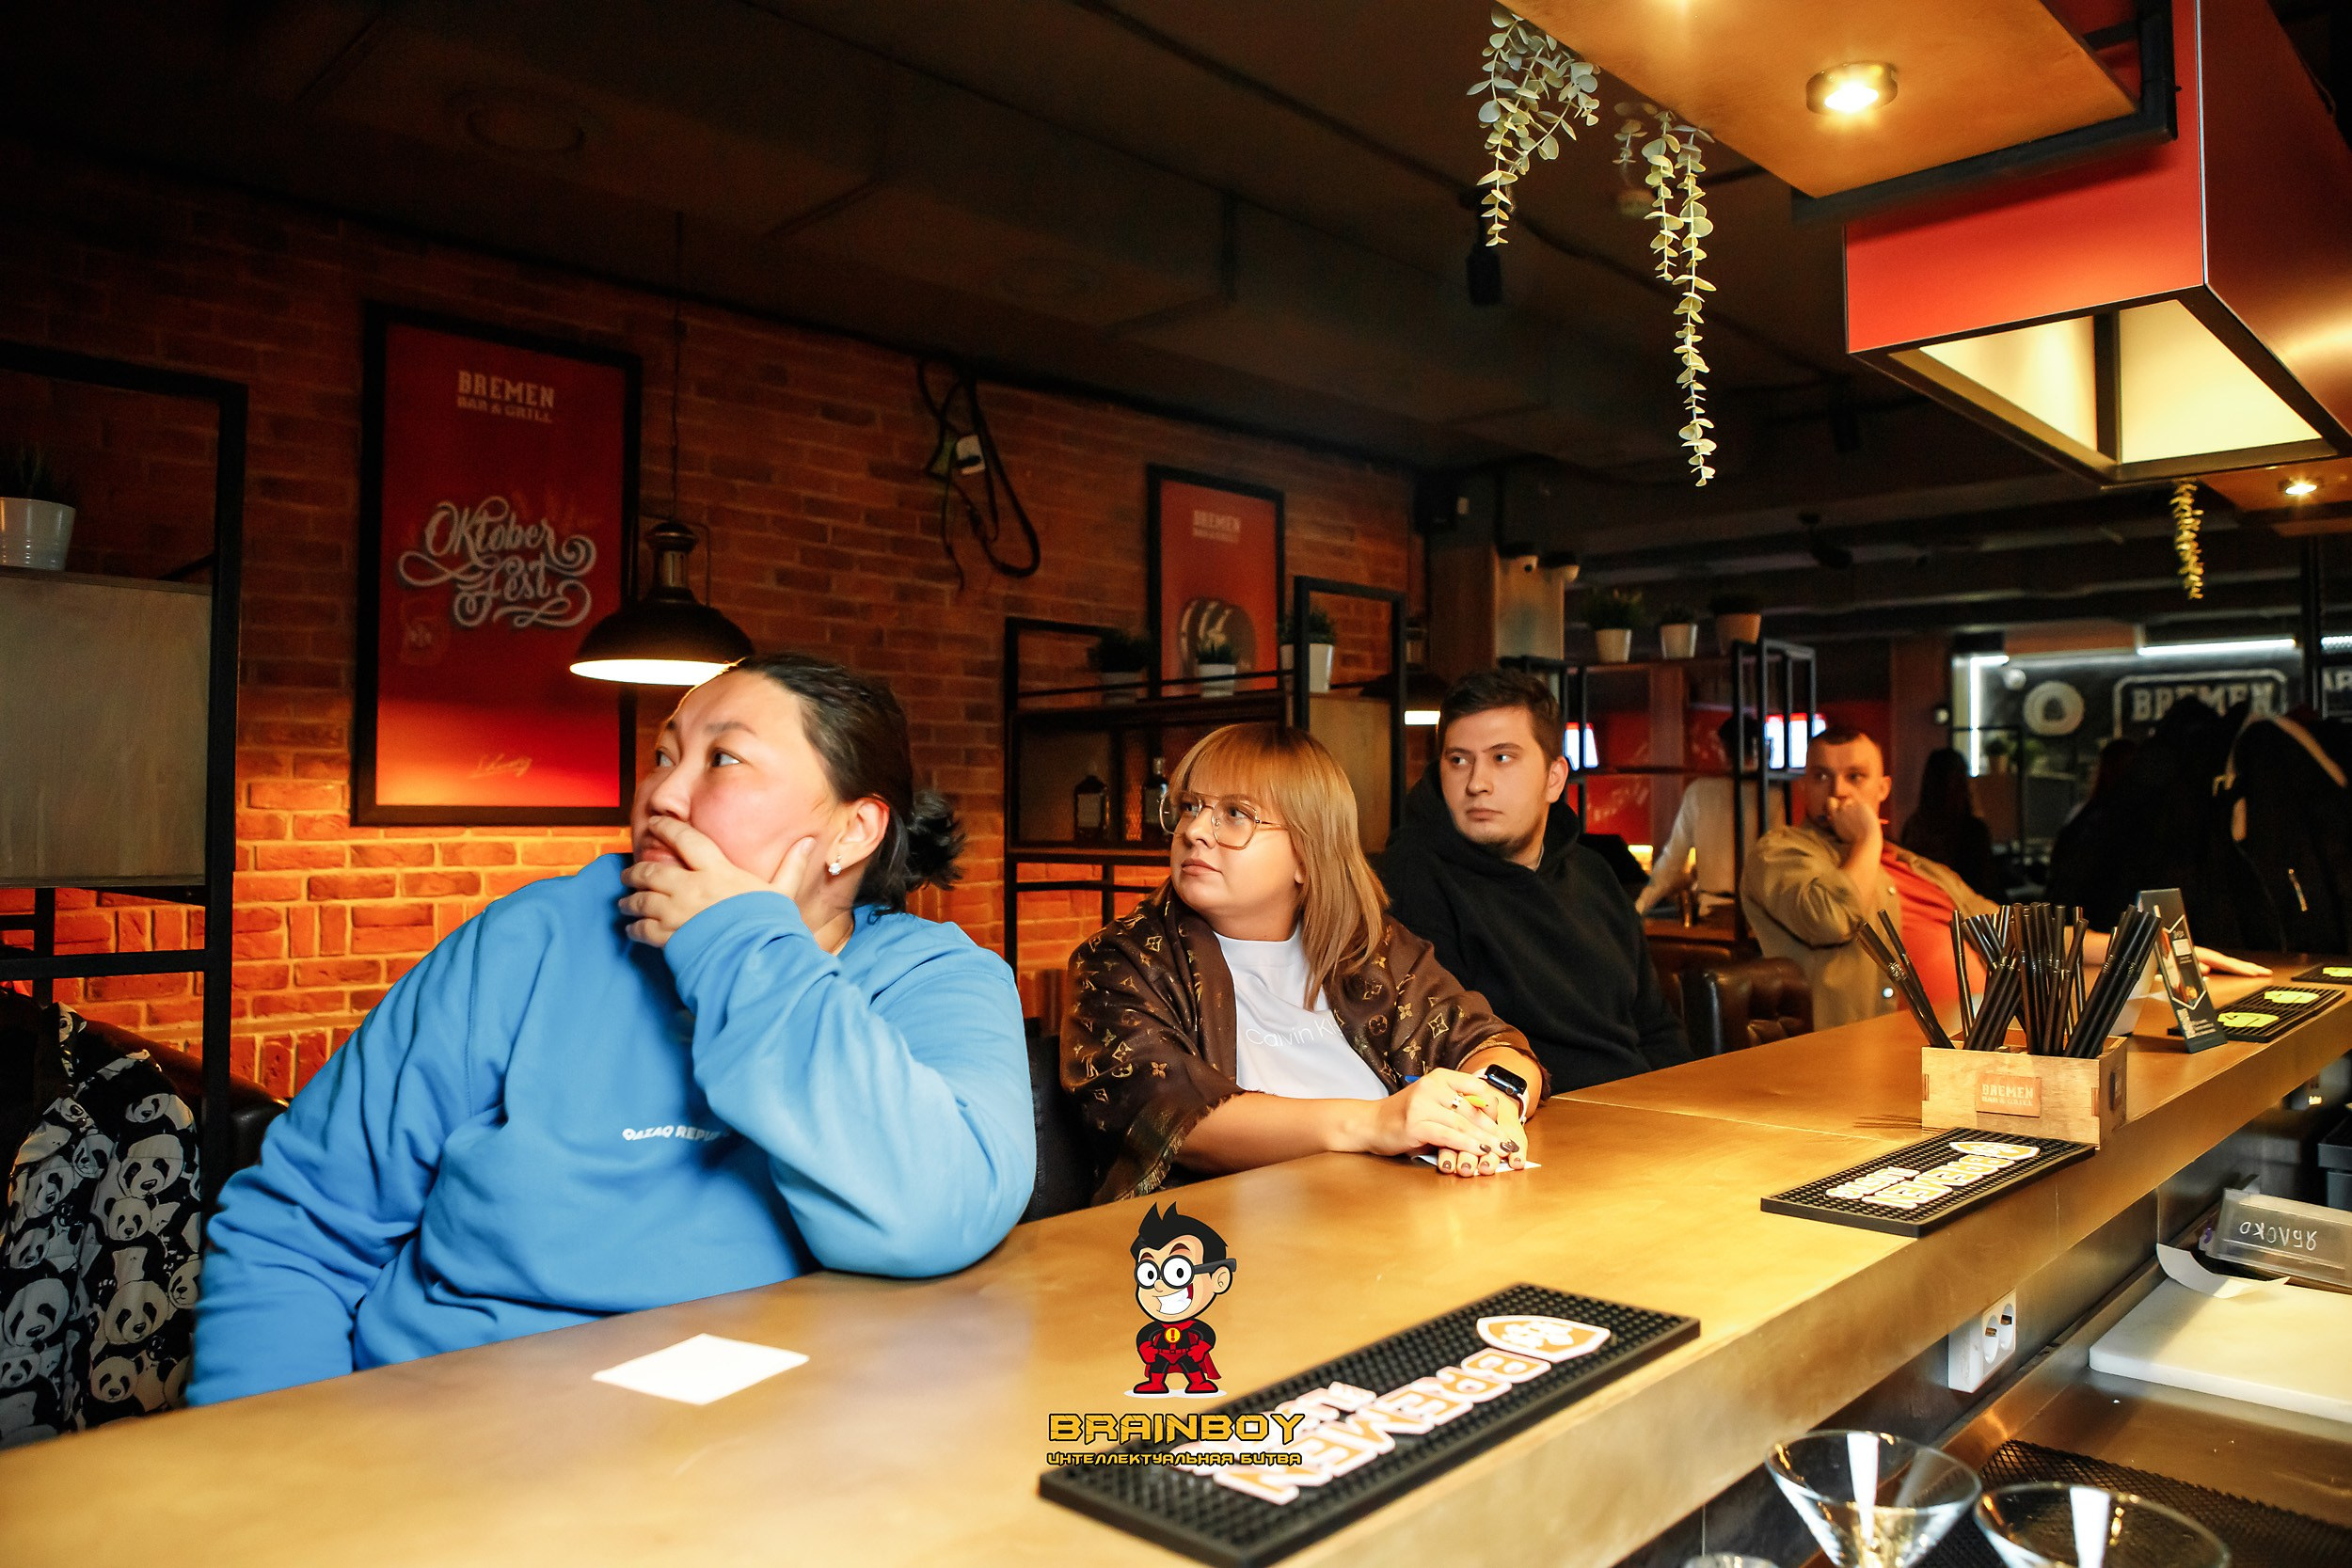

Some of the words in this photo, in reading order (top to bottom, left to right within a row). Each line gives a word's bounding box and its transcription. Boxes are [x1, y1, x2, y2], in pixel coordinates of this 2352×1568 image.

[457, 370, 555, 408] BREMEN
[453, 553, 592, 627] Fest
[1245, 1026, 1314, 1047] Calvin
[1980, 1084, 2034, 1099] BREMEN
[622, 1125, 675, 1141] QAZAQ
[1861, 1154, 2015, 1210] BREMEN
[2239, 1221, 2318, 1251] ЯБЛОКО
[1214, 1348, 1552, 1504] BREMEN
